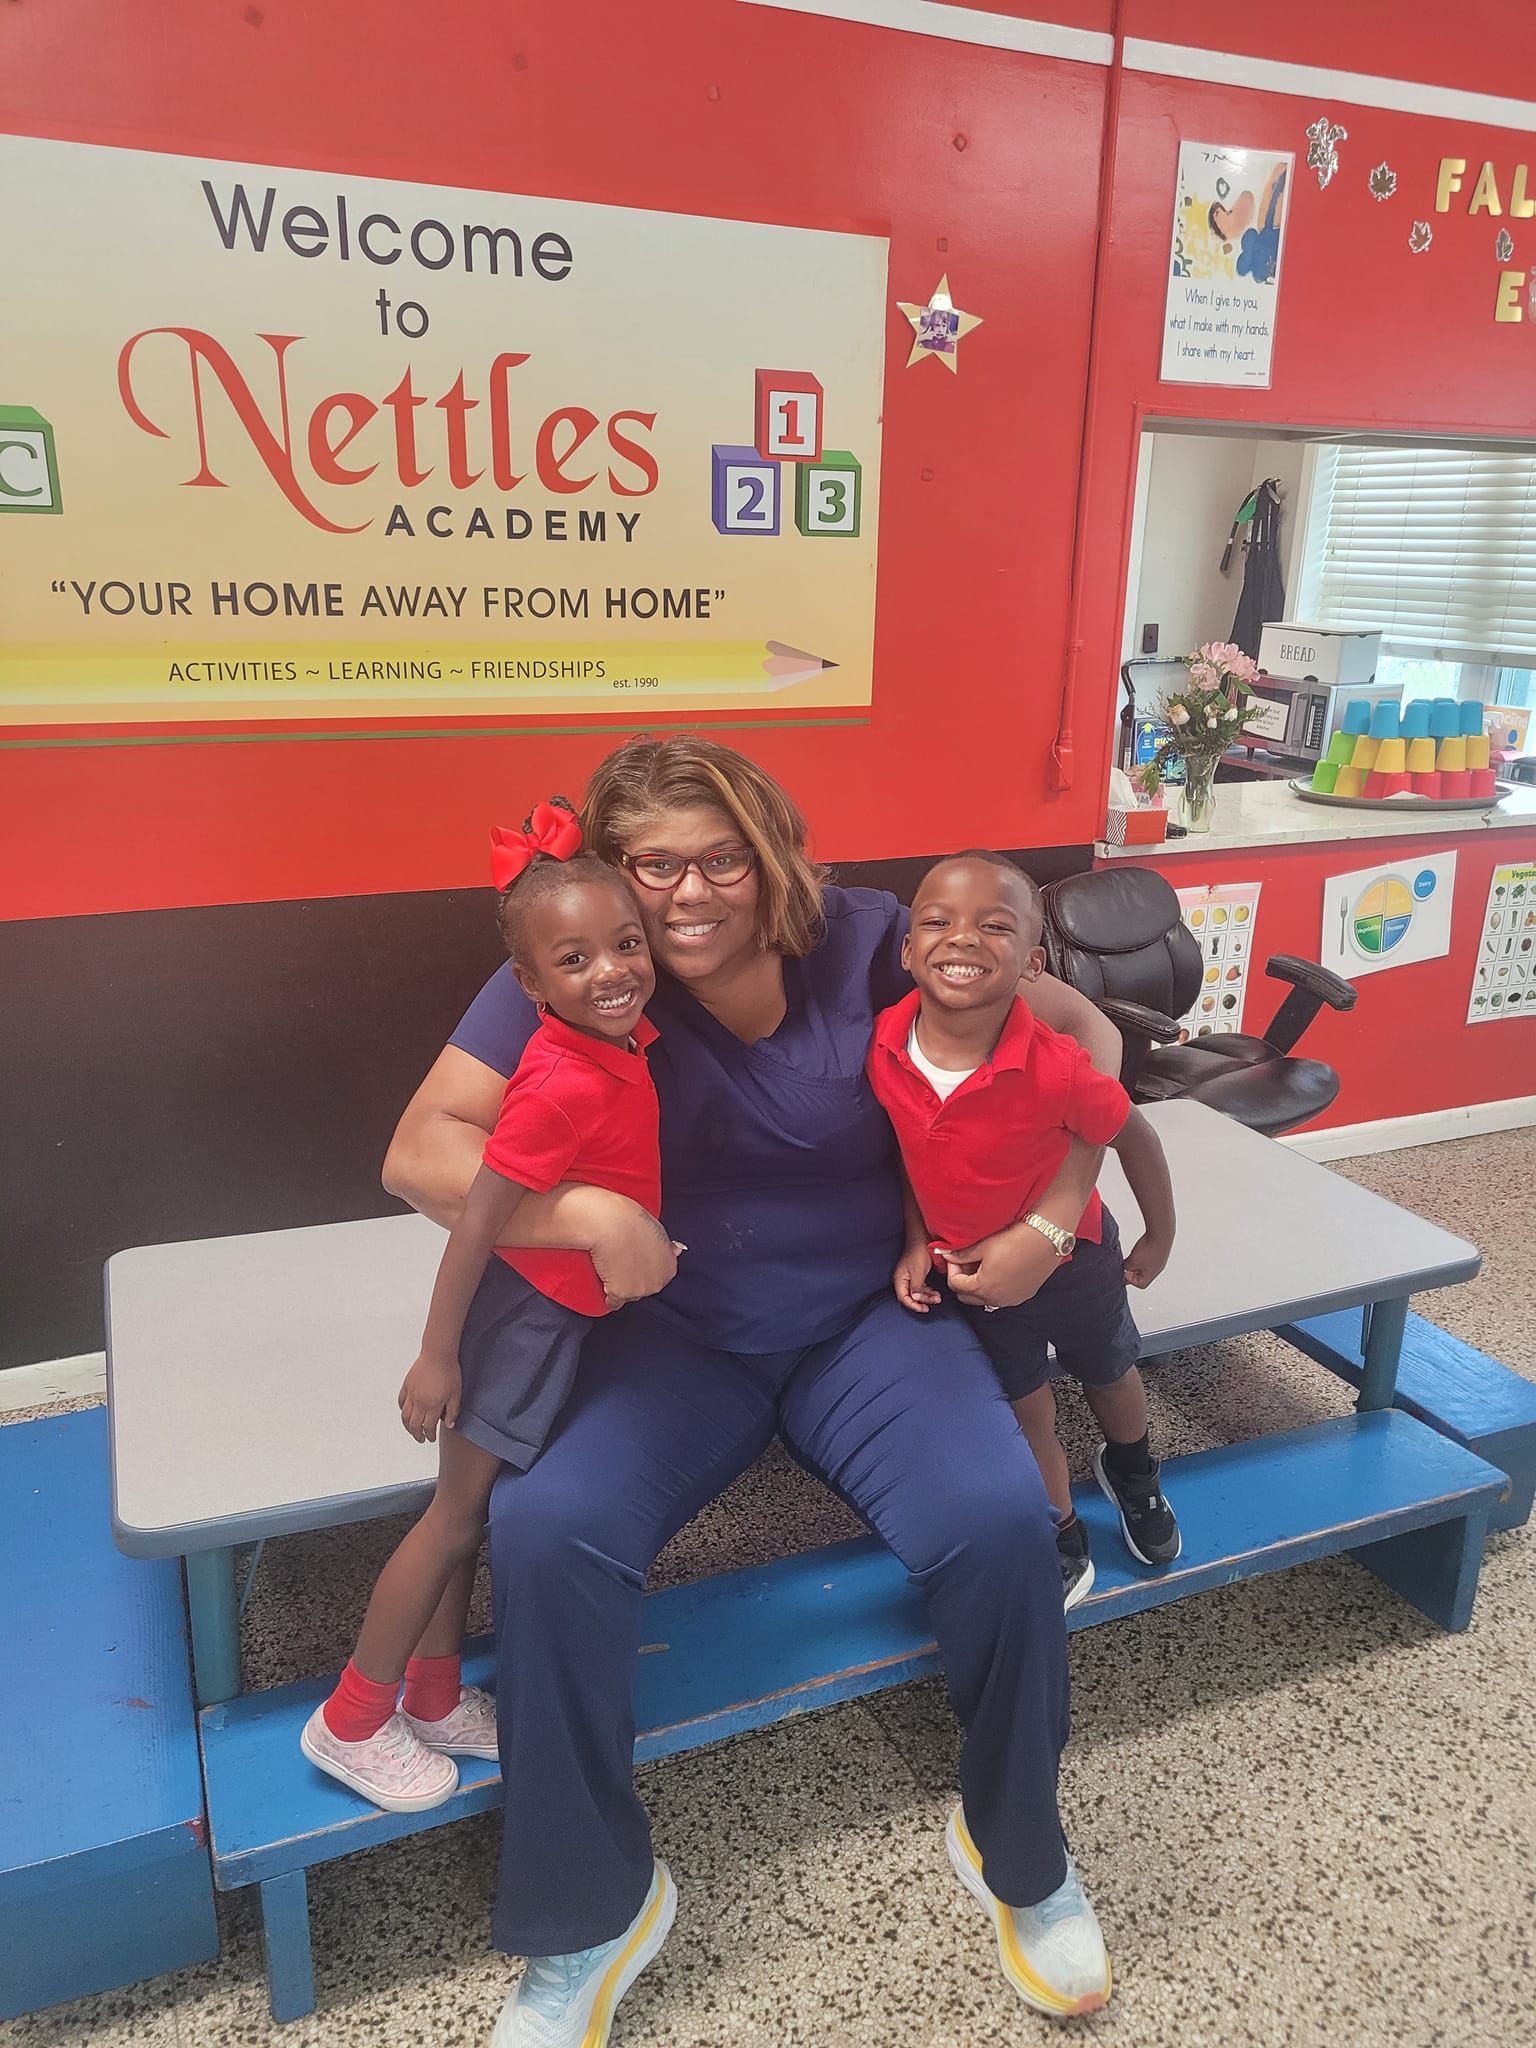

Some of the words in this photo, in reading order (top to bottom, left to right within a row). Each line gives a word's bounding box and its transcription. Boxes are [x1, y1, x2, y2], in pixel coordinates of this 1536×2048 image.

[1435, 158, 1536, 218] FAL
[201, 179, 573, 282] Welcome
[376, 288, 430, 339] to
[1185, 288, 1208, 305] When
[1210, 290, 1214, 305] I
[1215, 294, 1230, 311] give
[1233, 296, 1241, 307] to
[1169, 313, 1186, 330] what
[1188, 315, 1192, 330] I
[1193, 317, 1213, 332] make
[1215, 318, 1229, 333] with
[1231, 323, 1243, 337] my
[1177, 340, 1181, 356] I
[1182, 341, 1201, 358] share
[1204, 343, 1217, 359] with
[1220, 348, 1232, 363] my
[117, 326, 660, 534] Nettles
[779, 400, 805, 444] 1
[0, 440, 43, 497] C
[737, 476, 766, 521] 2
[818, 479, 847, 524] 3
[385, 504, 641, 543] ACADEMY
[51, 580, 193, 618] “YOUR
[211, 581, 344, 618] HOME
[360, 585, 468, 618] AWAY
[483, 587, 589, 619] FROM
[605, 587, 725, 620] HOME”
[168, 662, 297, 682] ACTIVITIES
[328, 661, 442, 680] LEARNING
[471, 660, 606, 678] FRIENDSHIPS
[1280, 644, 1316, 663] BREAD
[613, 679, 631, 688] est.
[634, 677, 659, 688] 1990
